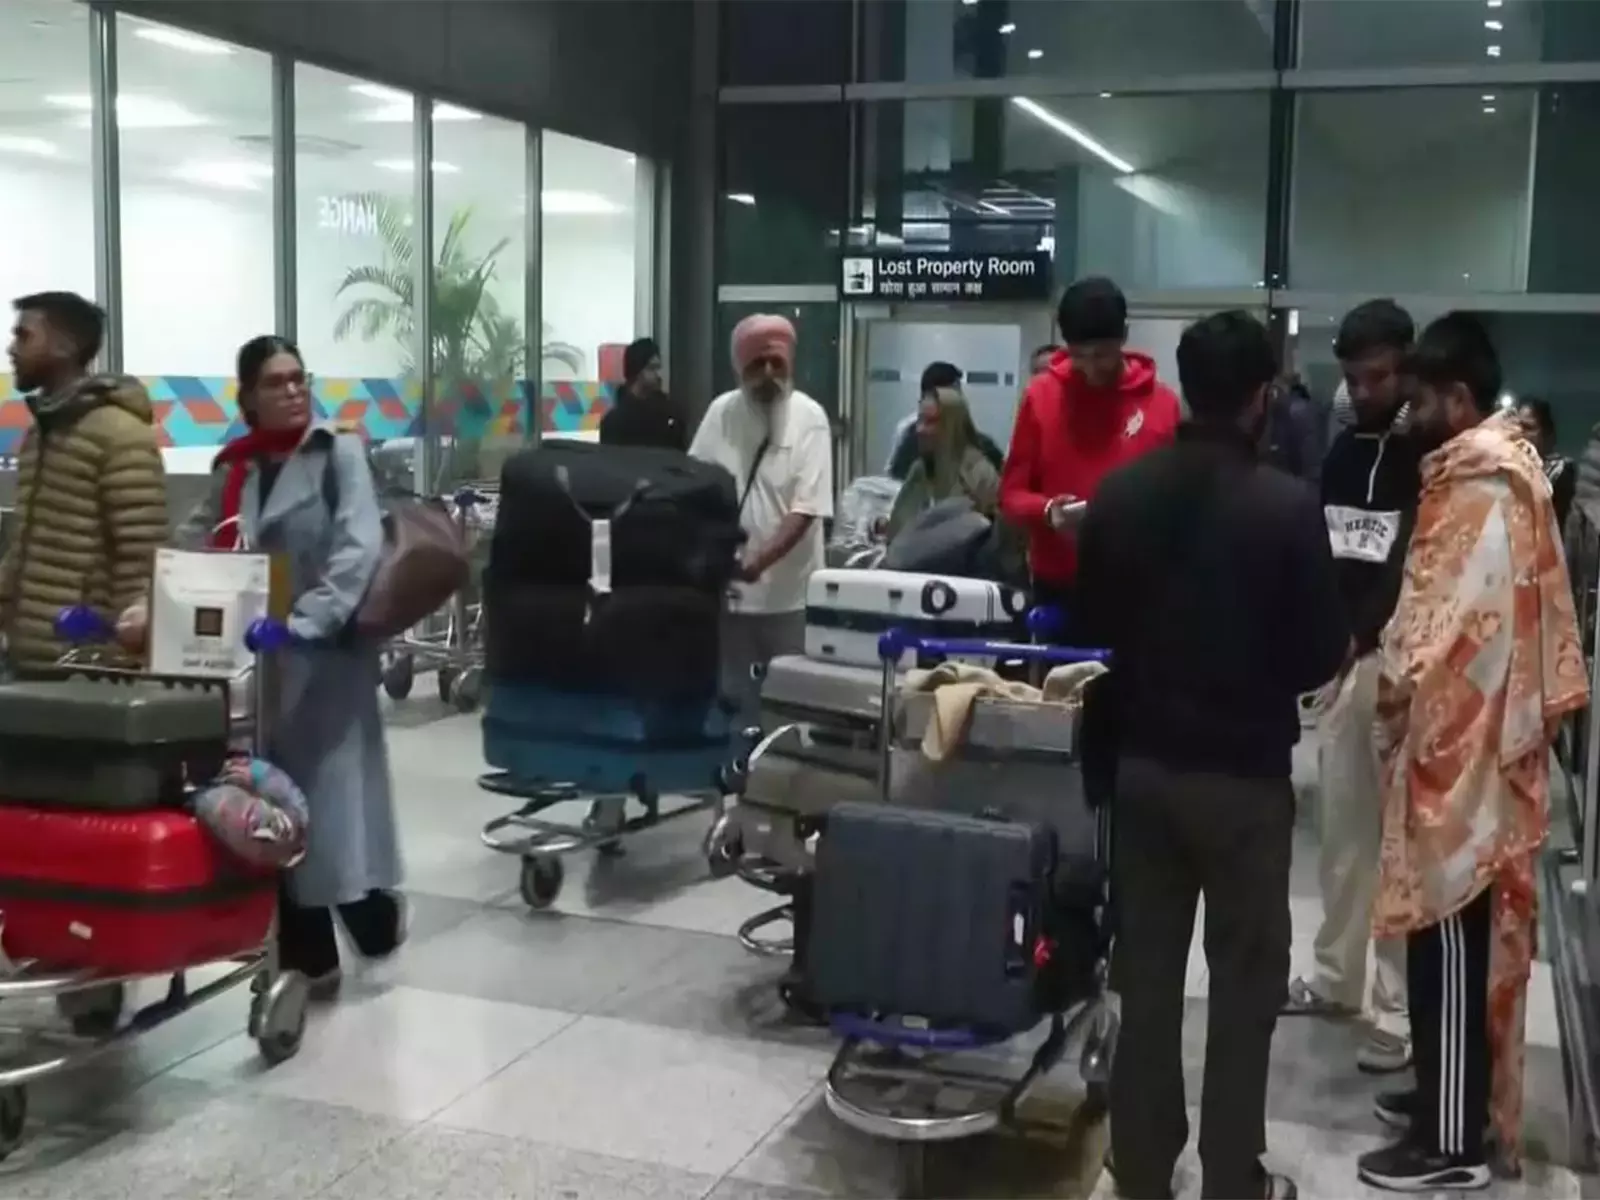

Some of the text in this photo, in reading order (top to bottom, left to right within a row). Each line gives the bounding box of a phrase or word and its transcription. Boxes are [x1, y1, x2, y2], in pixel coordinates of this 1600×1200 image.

[878, 256, 1036, 279] Lost Property Room
